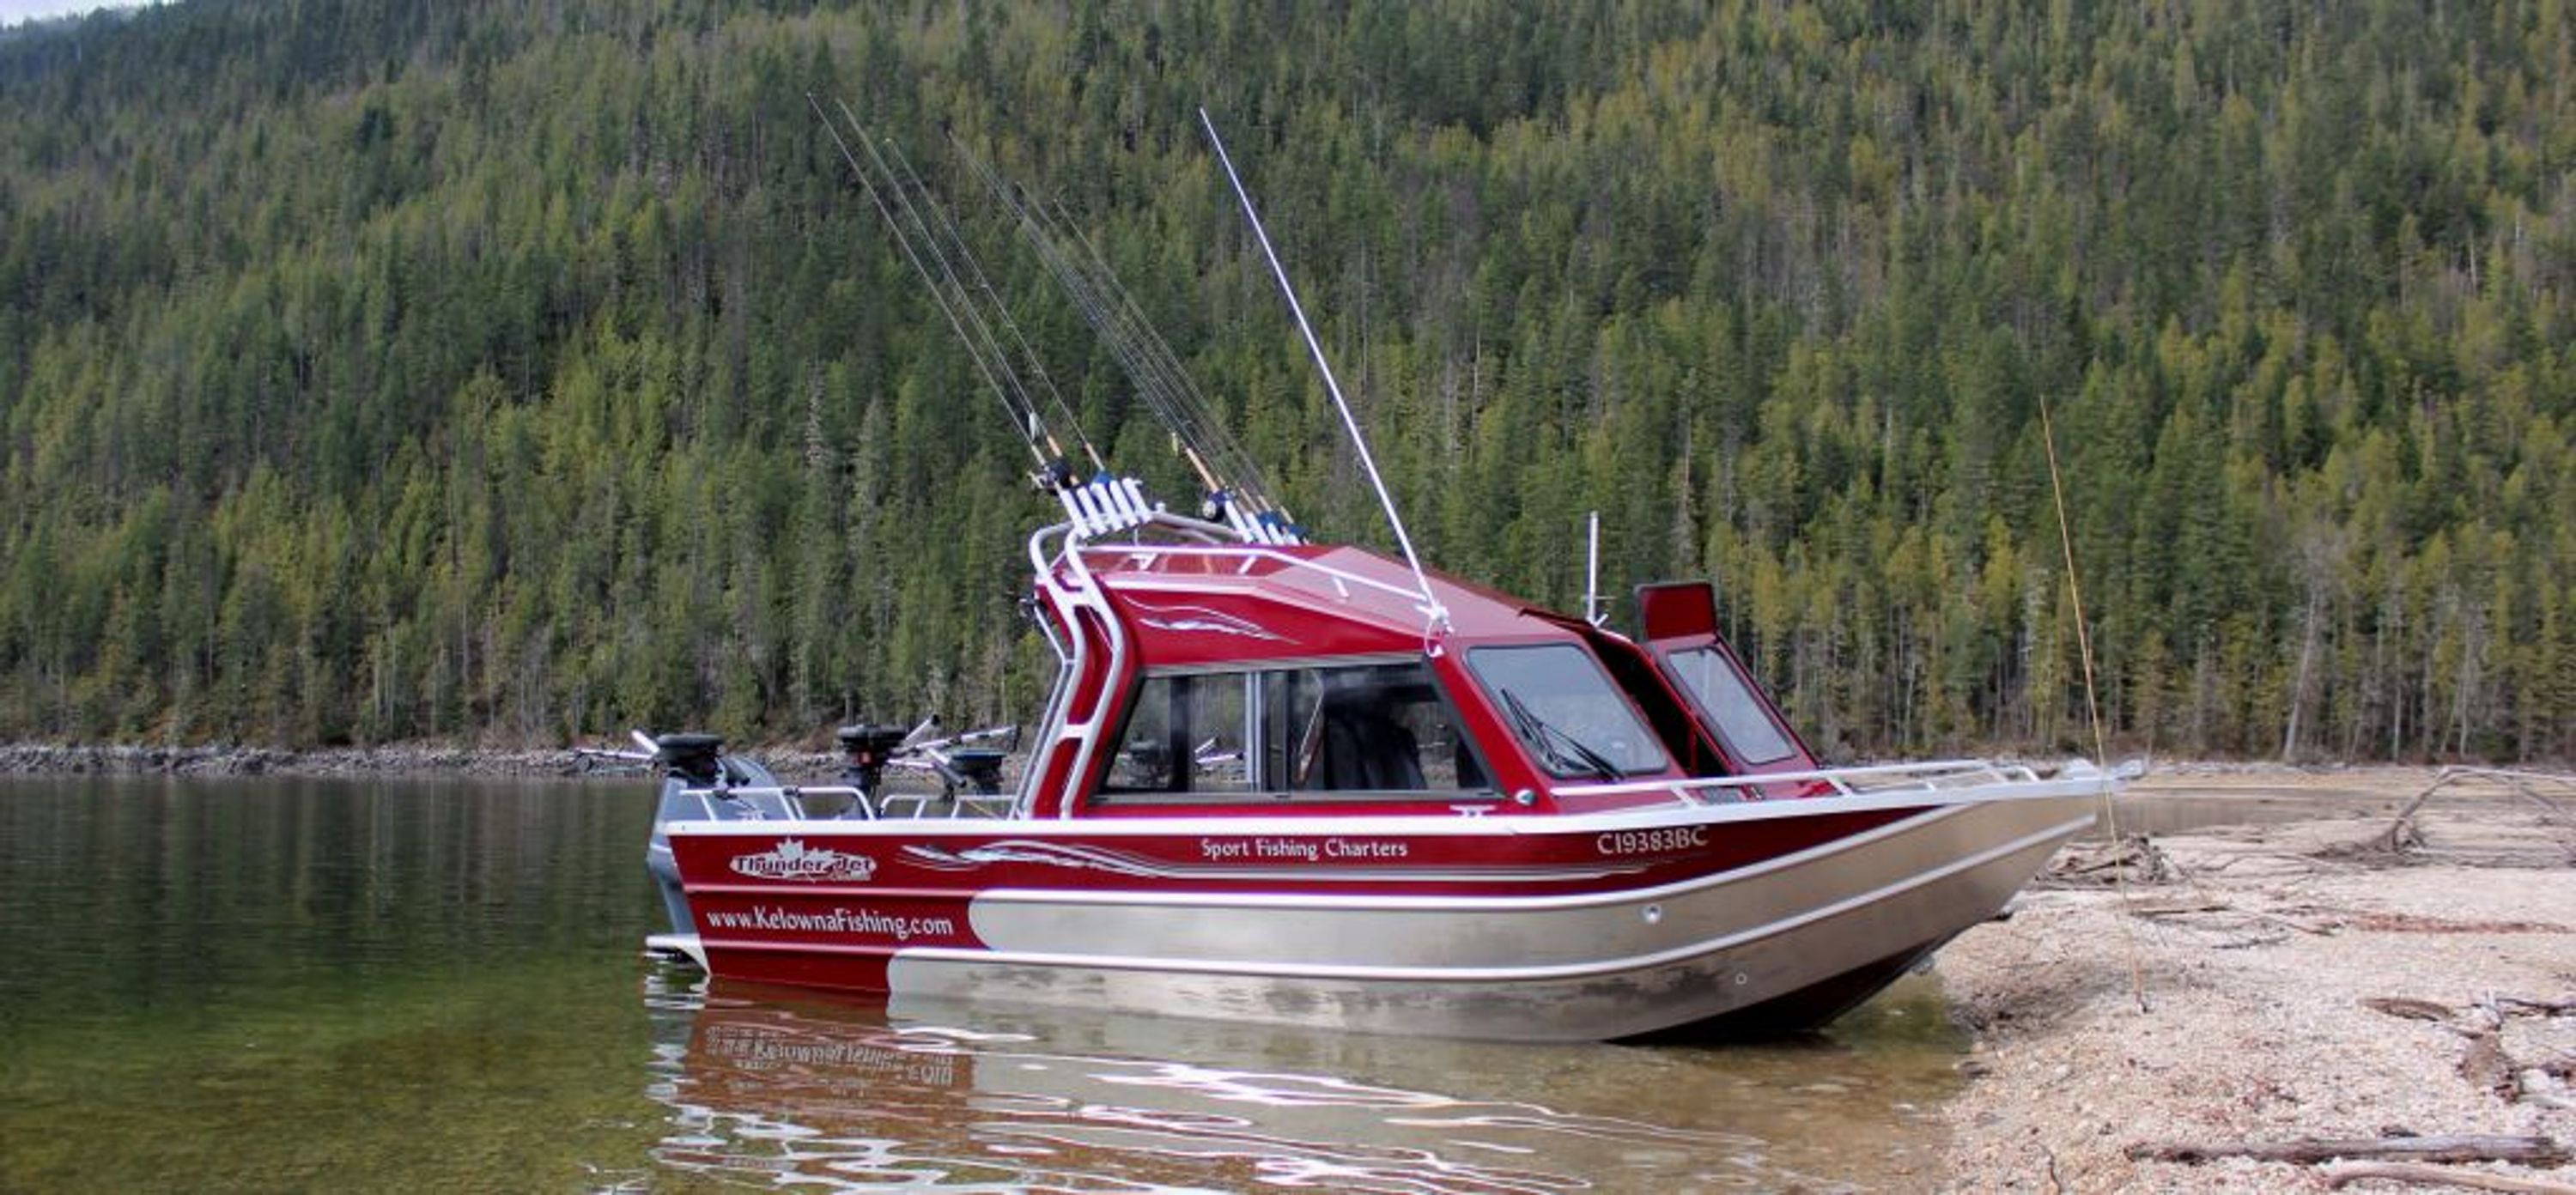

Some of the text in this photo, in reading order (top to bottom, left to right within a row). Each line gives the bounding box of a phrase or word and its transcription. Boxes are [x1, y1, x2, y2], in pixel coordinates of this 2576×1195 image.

[1200, 838, 1408, 860] Sport Fishing Charters
[737, 856, 872, 872] Thunder Jet
[707, 906, 953, 939] www.KelownaFishing.com
